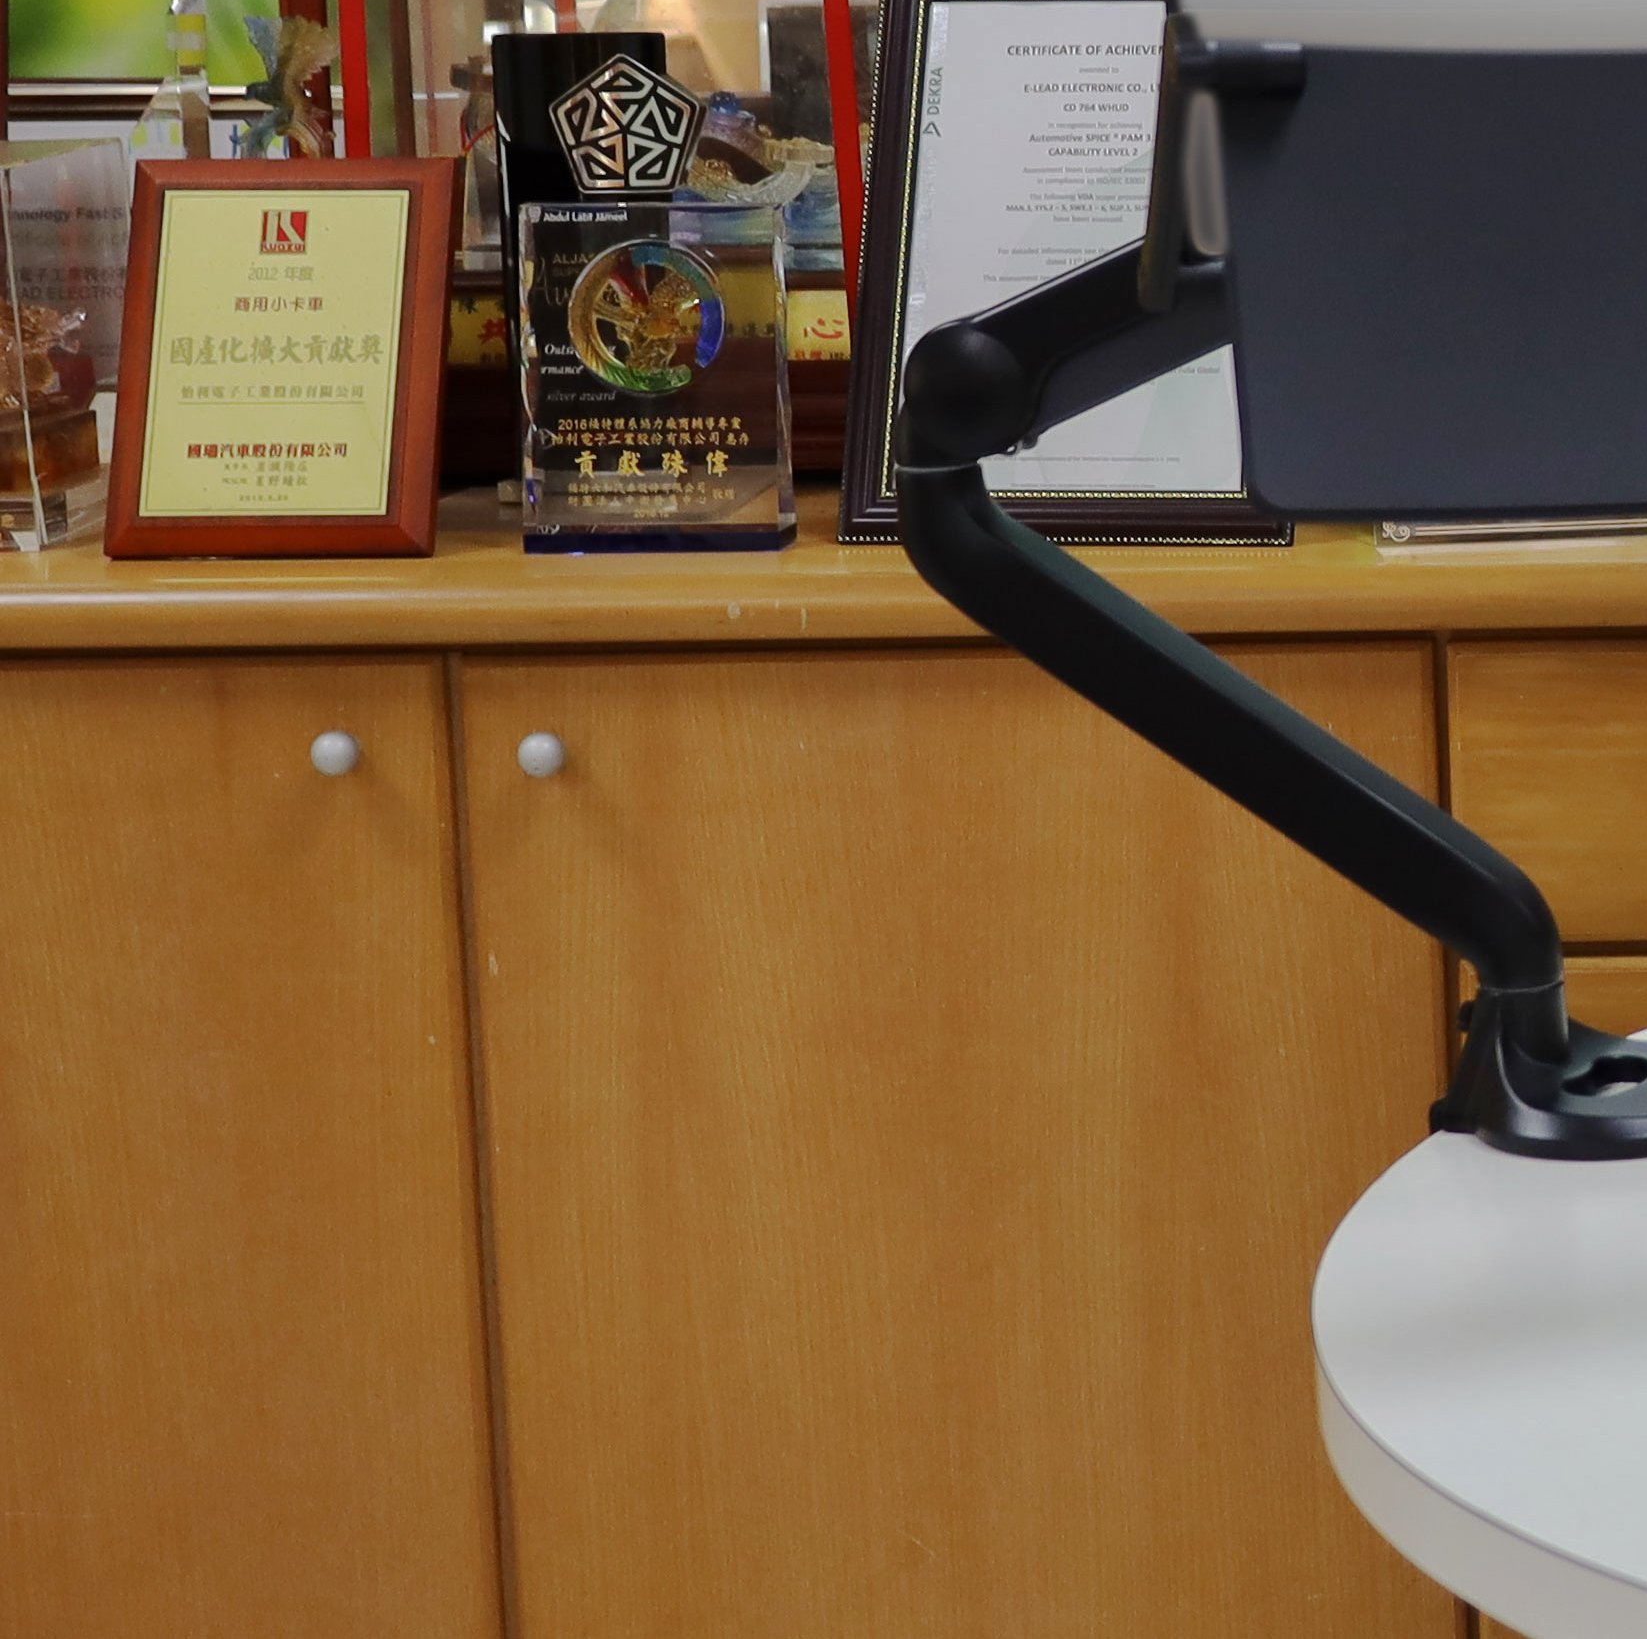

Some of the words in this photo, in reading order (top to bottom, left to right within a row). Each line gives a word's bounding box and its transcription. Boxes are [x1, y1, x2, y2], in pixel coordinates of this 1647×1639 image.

[1007, 44, 1082, 56] CERTIFICATE
[1085, 44, 1102, 56] OF
[926, 66, 944, 116] DEKRA
[1024, 83, 1060, 93] E-LEAD
[1062, 83, 1124, 93] ELECTRONIC
[1098, 102, 1129, 112] WHUD
[1029, 134, 1083, 143] Automotive
[1085, 134, 1111, 143] SPICE
[1120, 134, 1144, 143] PAM
[1048, 147, 1101, 157] CAPABILITY
[1103, 147, 1130, 157] LEVEL
[1132, 147, 1138, 157] 2
[234, 296, 323, 312] 商用小卡車
